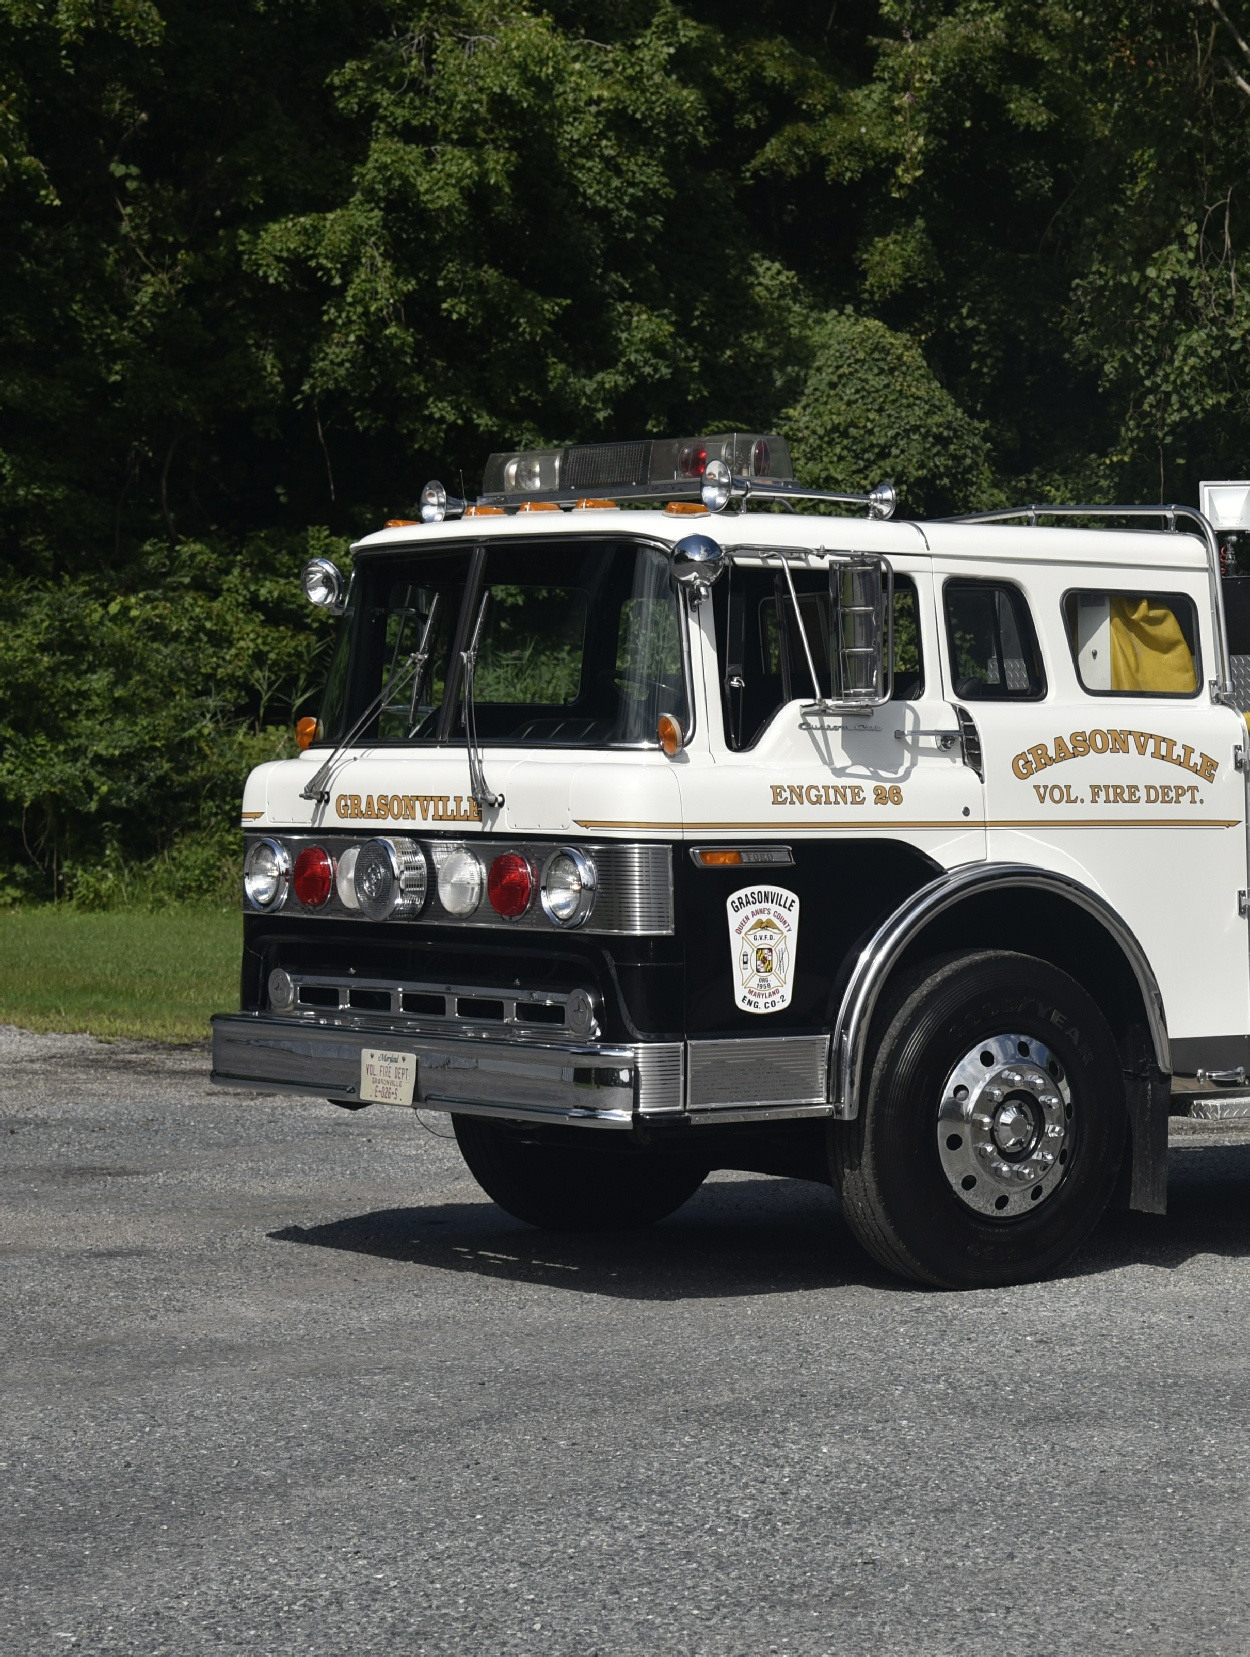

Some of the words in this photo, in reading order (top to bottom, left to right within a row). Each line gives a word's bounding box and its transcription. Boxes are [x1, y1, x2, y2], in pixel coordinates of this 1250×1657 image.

[1012, 729, 1219, 783] GRASONVILLE
[770, 784, 866, 805] ENGINE
[873, 785, 903, 805] 26
[1033, 784, 1084, 804] VOL.
[1090, 784, 1141, 804] FIRE
[1145, 785, 1204, 804] DEPT.
[335, 794, 482, 822] GRASONVILLE
[746, 853, 774, 862] FORD
[731, 891, 796, 912] GRASONVILLE
[735, 915, 750, 934] QUEEN
[751, 908, 771, 917] ANNE'S
[773, 911, 792, 933] COUNTY
[742, 996, 761, 1009] ENG.
[764, 995, 786, 1009] CO-2
[748, 988, 780, 999] MARYLAND
[378, 1054, 399, 1065] Maryland
[380, 1065, 392, 1078] FIRE
[372, 1077, 402, 1088] GRASONVILLE
